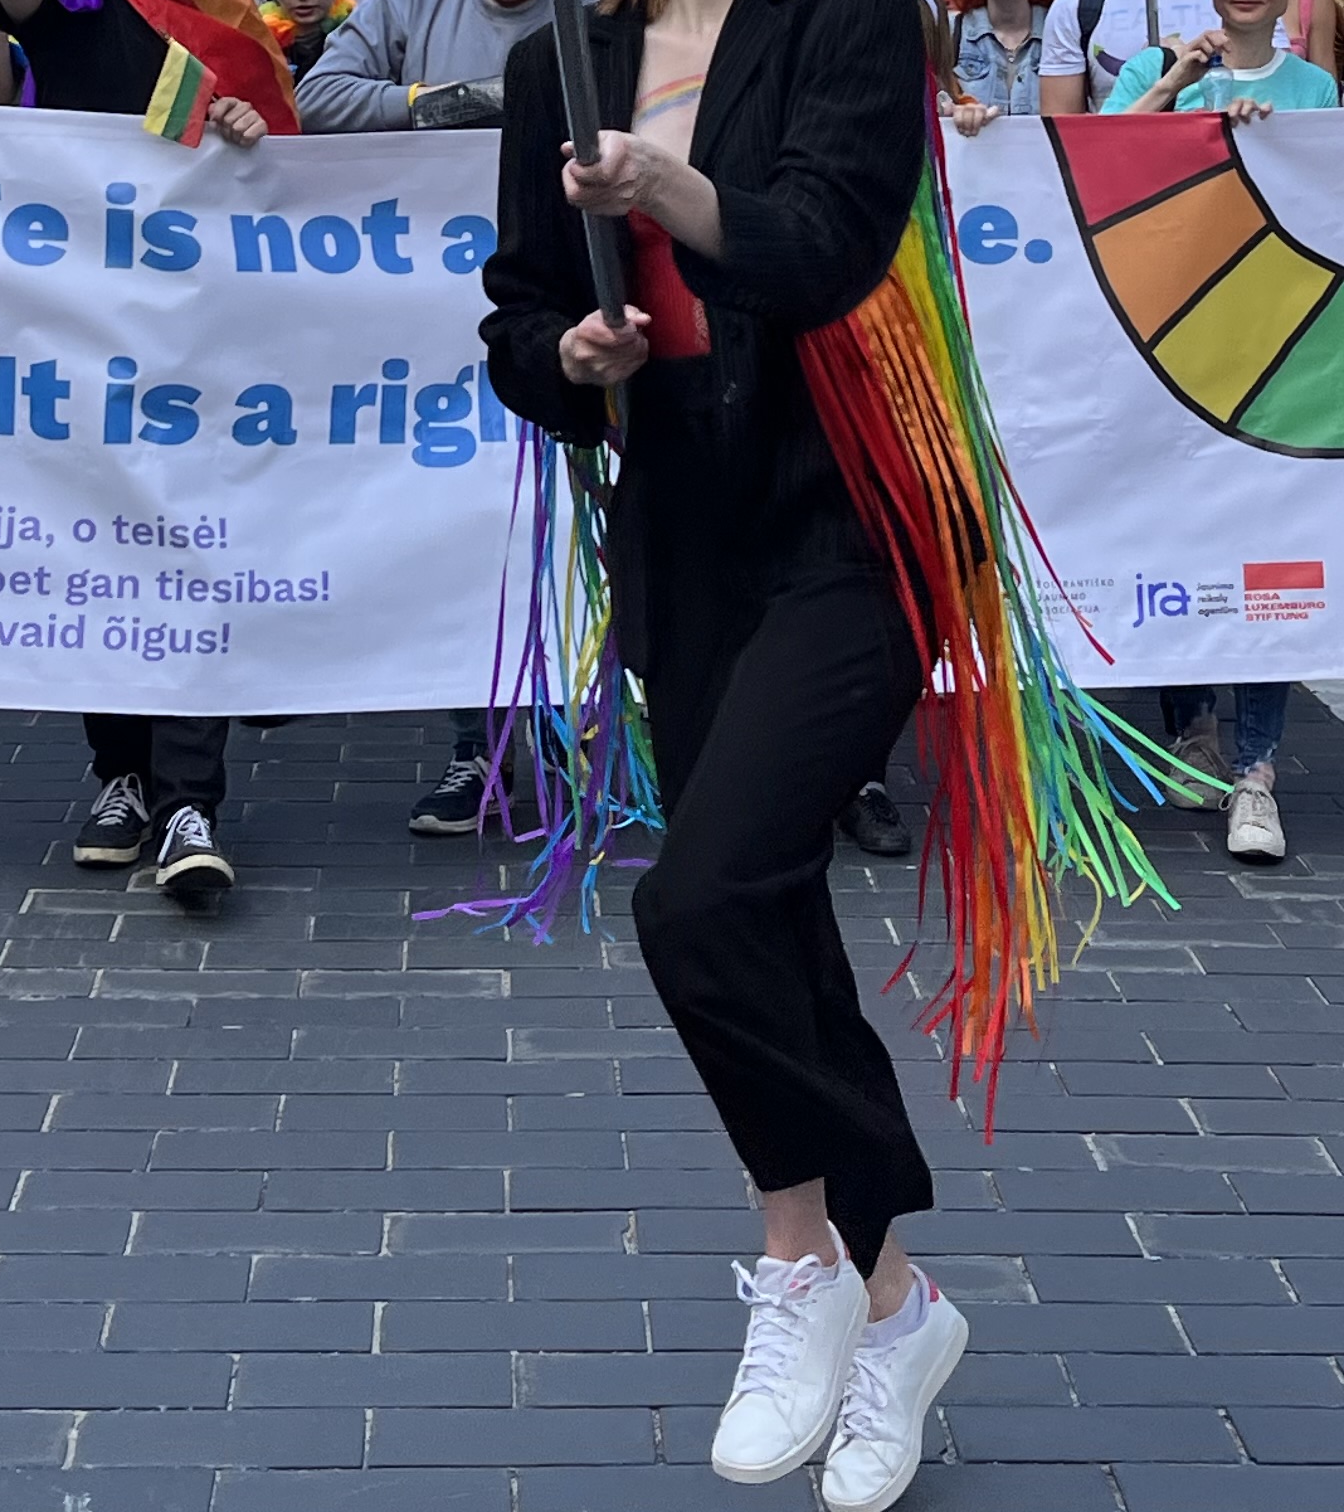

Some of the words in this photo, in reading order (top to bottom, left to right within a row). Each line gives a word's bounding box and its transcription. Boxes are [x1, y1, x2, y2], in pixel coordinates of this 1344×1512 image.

[105, 182, 202, 272] is
[230, 197, 413, 275] not
[103, 356, 202, 445] is
[231, 383, 297, 446] a
[72, 517, 97, 543] o
[112, 513, 228, 549] teisė!
[66, 571, 140, 606] gan
[156, 570, 331, 603] tiesības!
[1133, 573, 1191, 628] jra
[102, 616, 231, 662] õigus!
